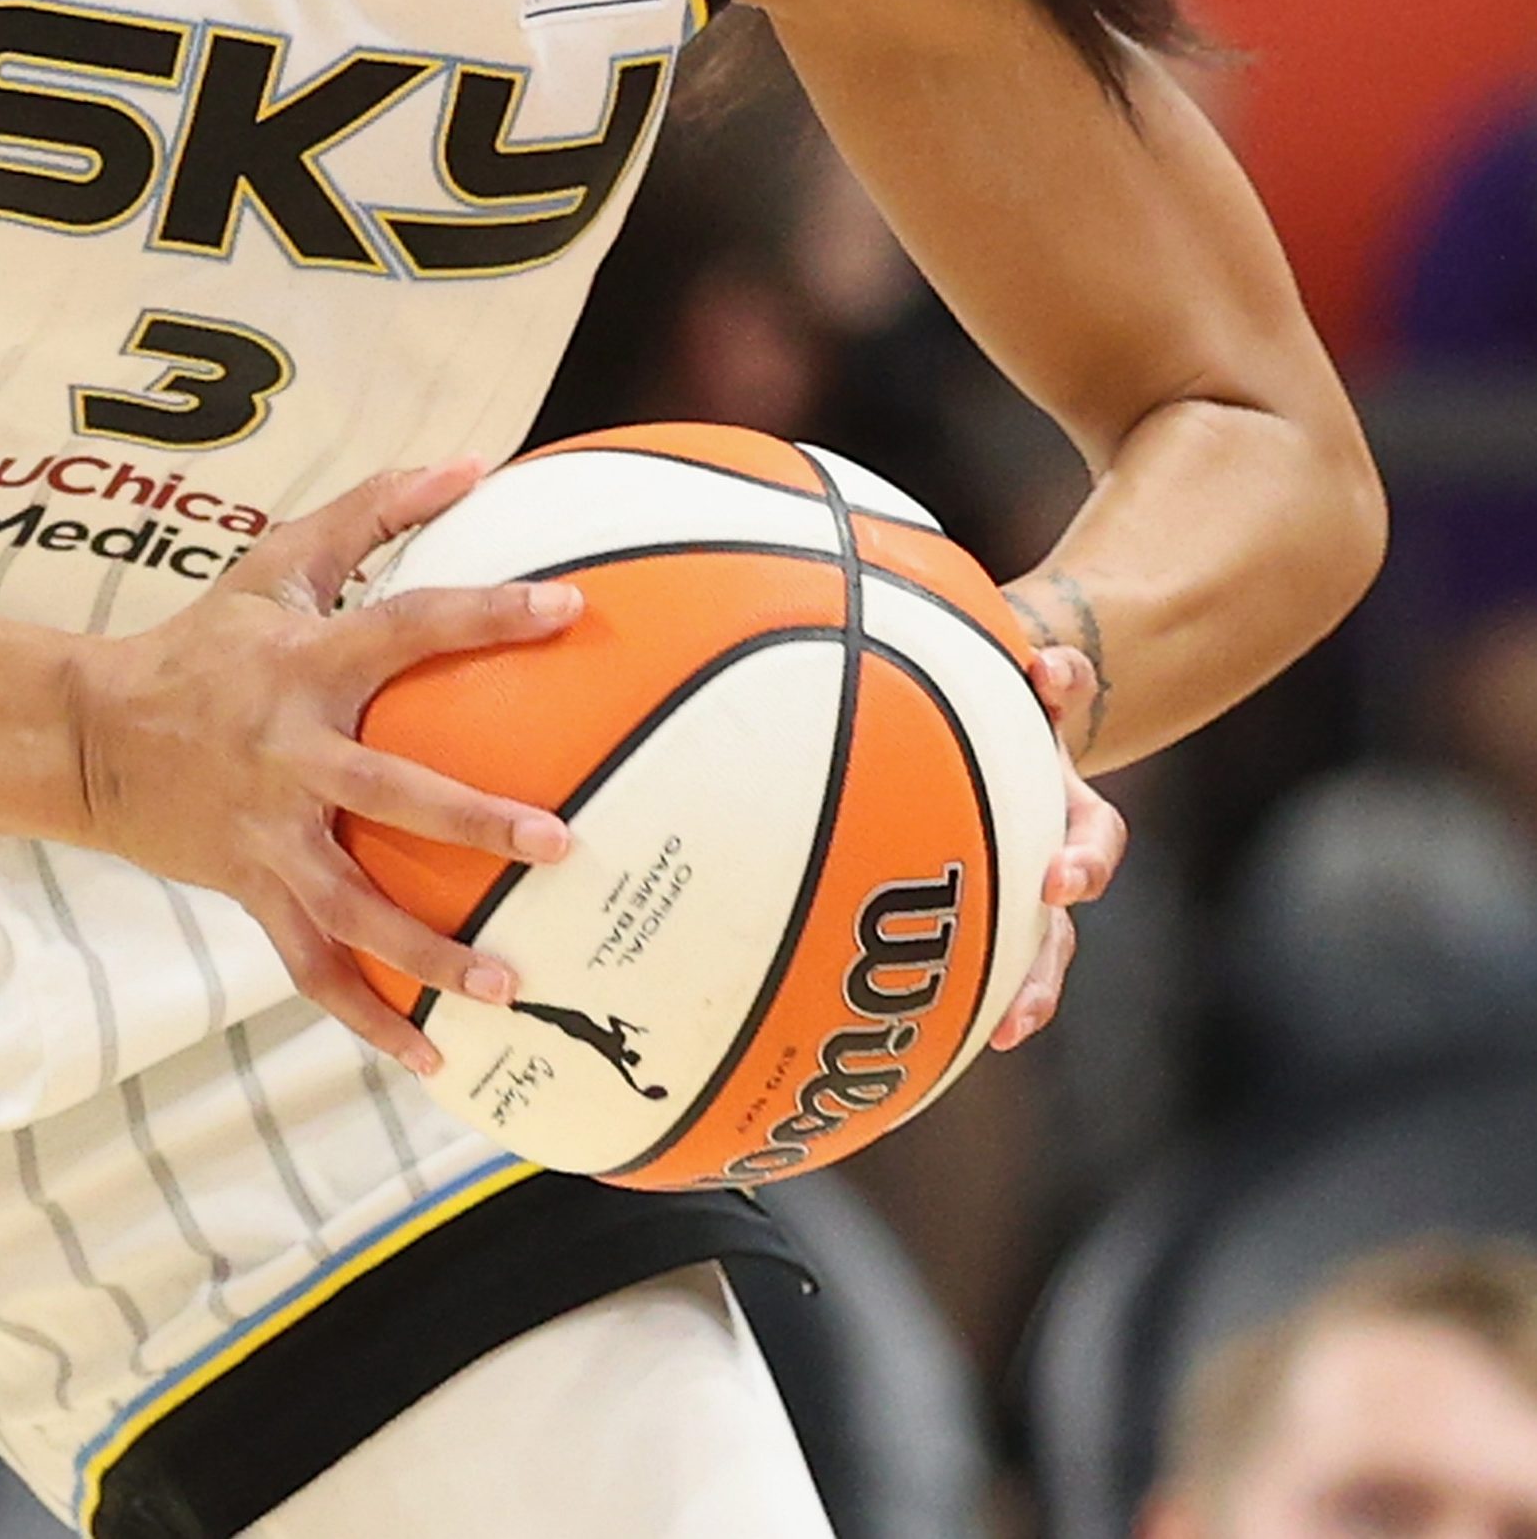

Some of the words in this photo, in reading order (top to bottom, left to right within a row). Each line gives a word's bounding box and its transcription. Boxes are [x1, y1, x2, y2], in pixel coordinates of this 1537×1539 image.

[69, 309, 295, 451] 3
[615, 863, 693, 968] OFFICIAL
[627, 834, 682, 910] GAME
[586, 910, 635, 971] BALL
[693, 860, 964, 1185] Wilso
